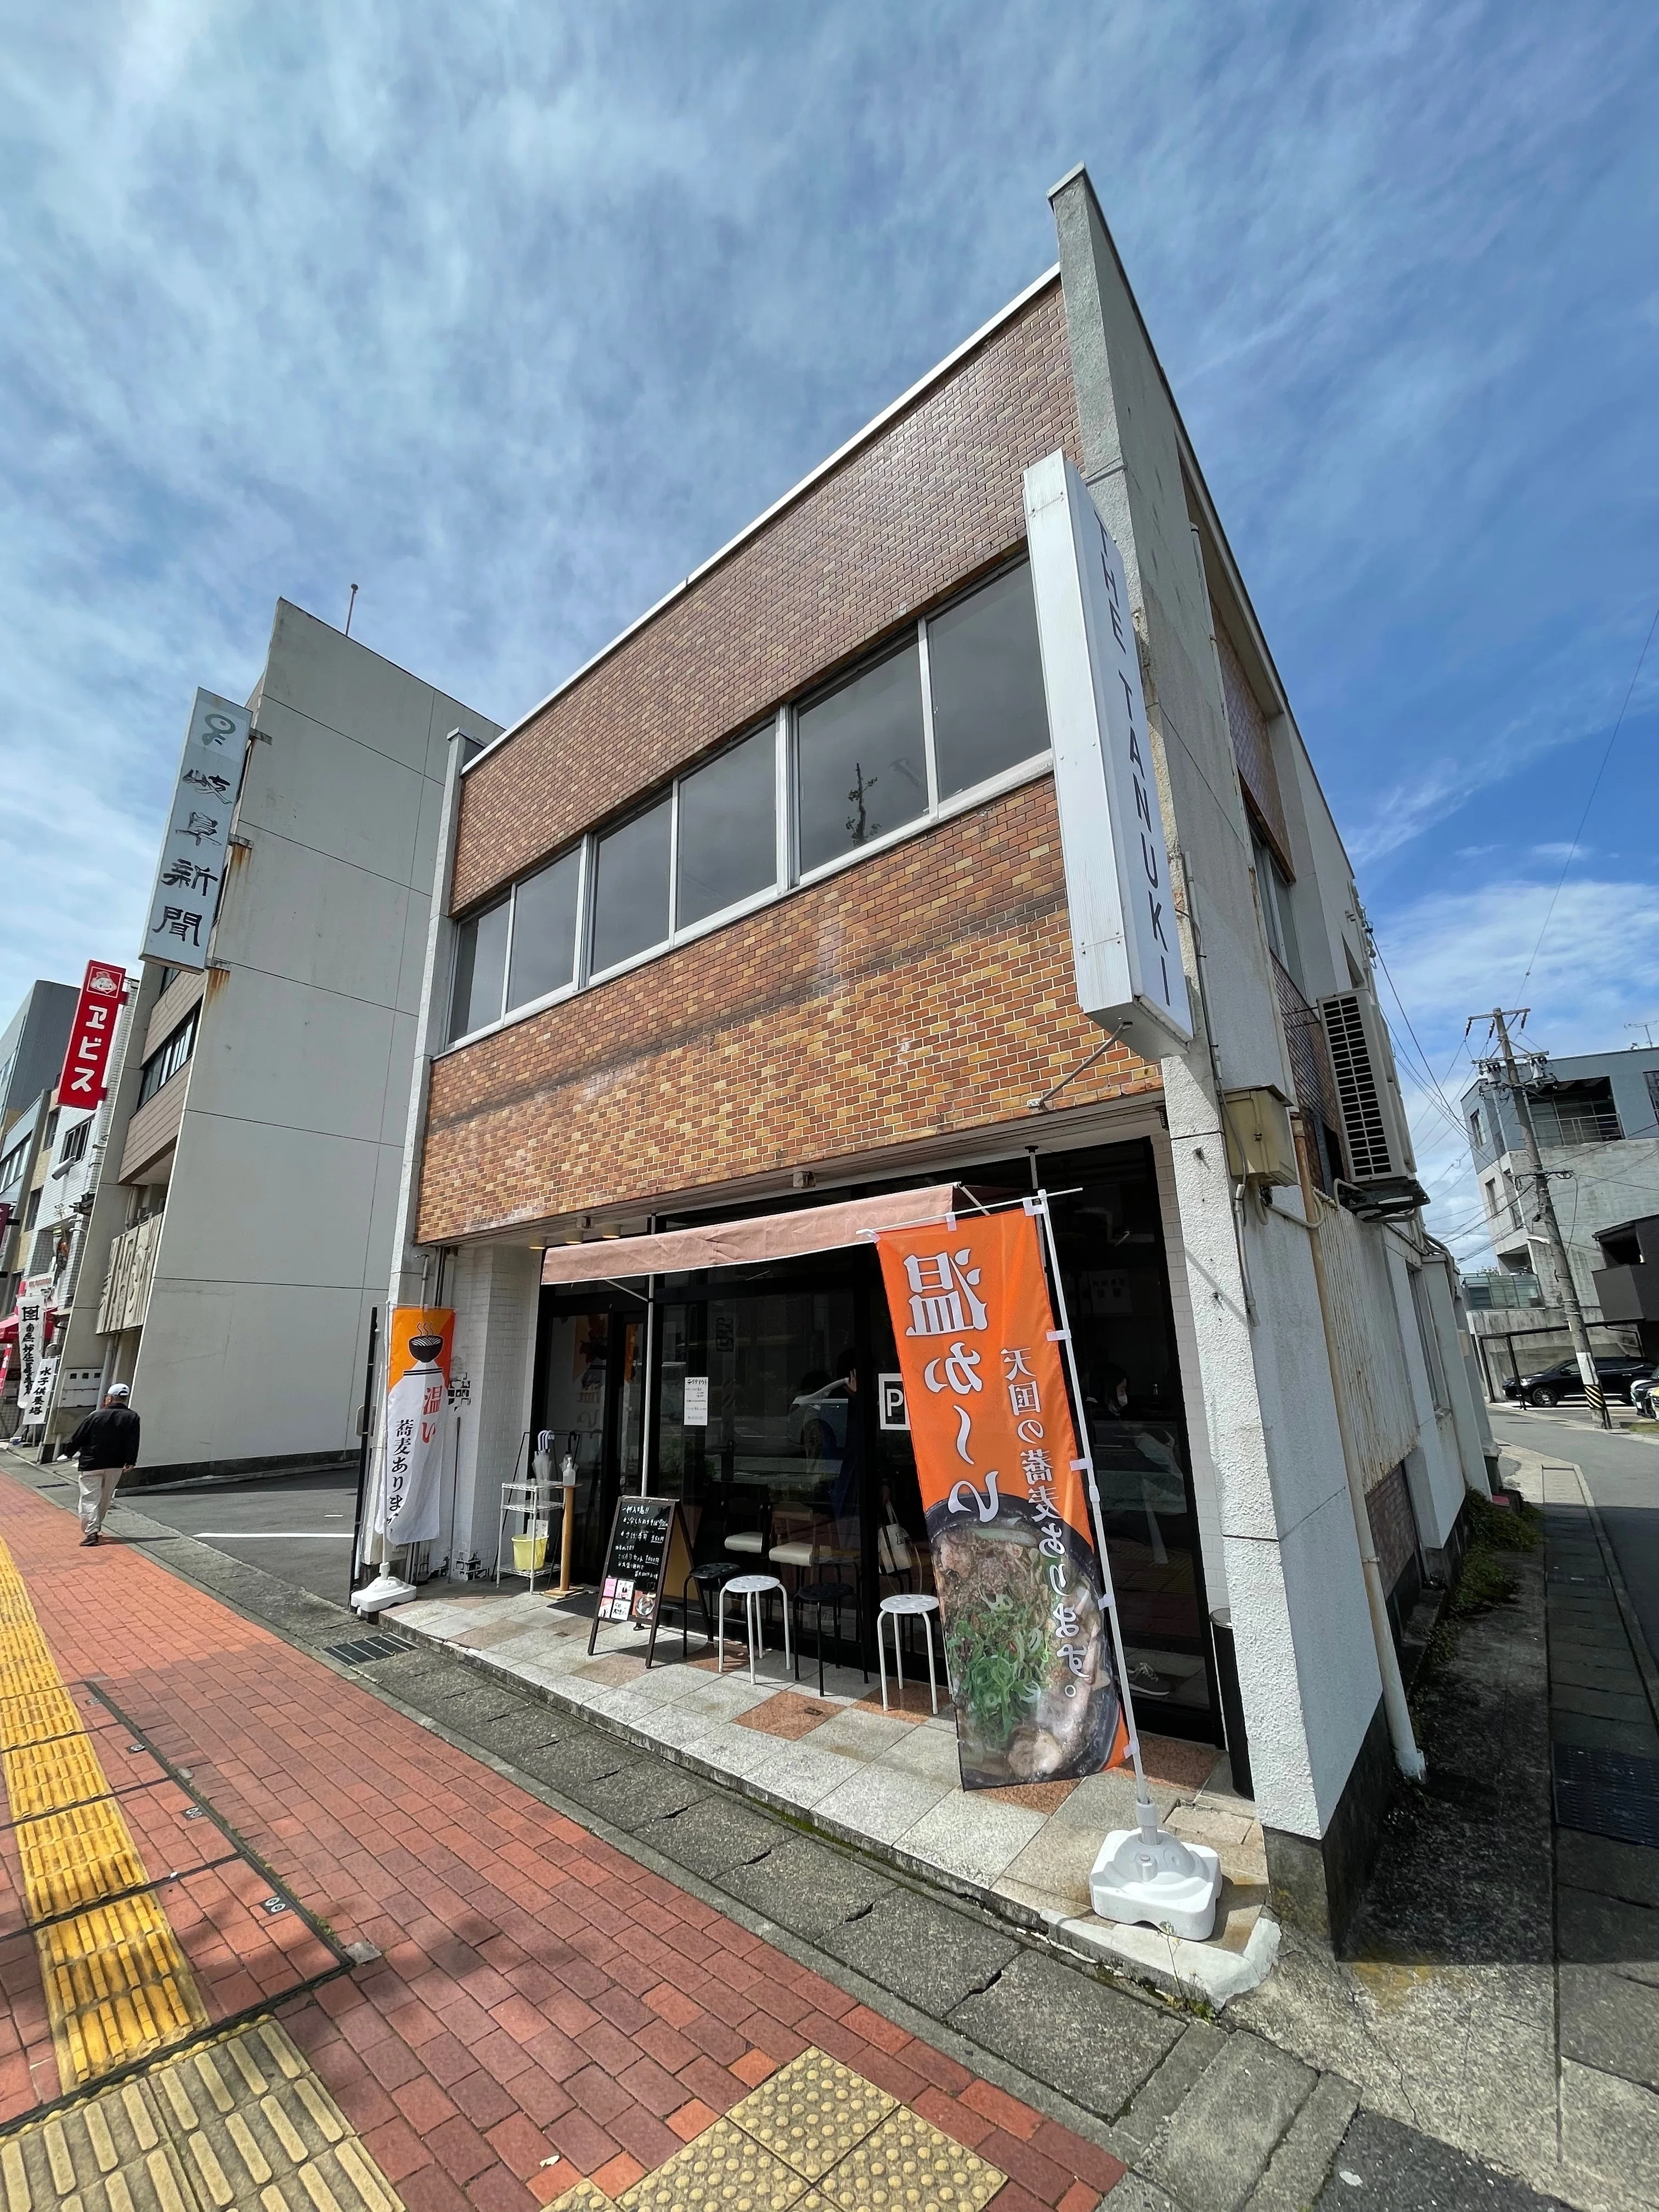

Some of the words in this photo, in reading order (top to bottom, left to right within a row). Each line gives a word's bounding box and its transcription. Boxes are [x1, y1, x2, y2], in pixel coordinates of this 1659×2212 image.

[1093, 508, 1127, 656] THE
[1118, 669, 1170, 1007] TANUKI
[152, 768, 233, 947] 岐阜新聞
[29, 1367, 52, 1415] 水子供養塔
[887, 1389, 904, 1417] P
